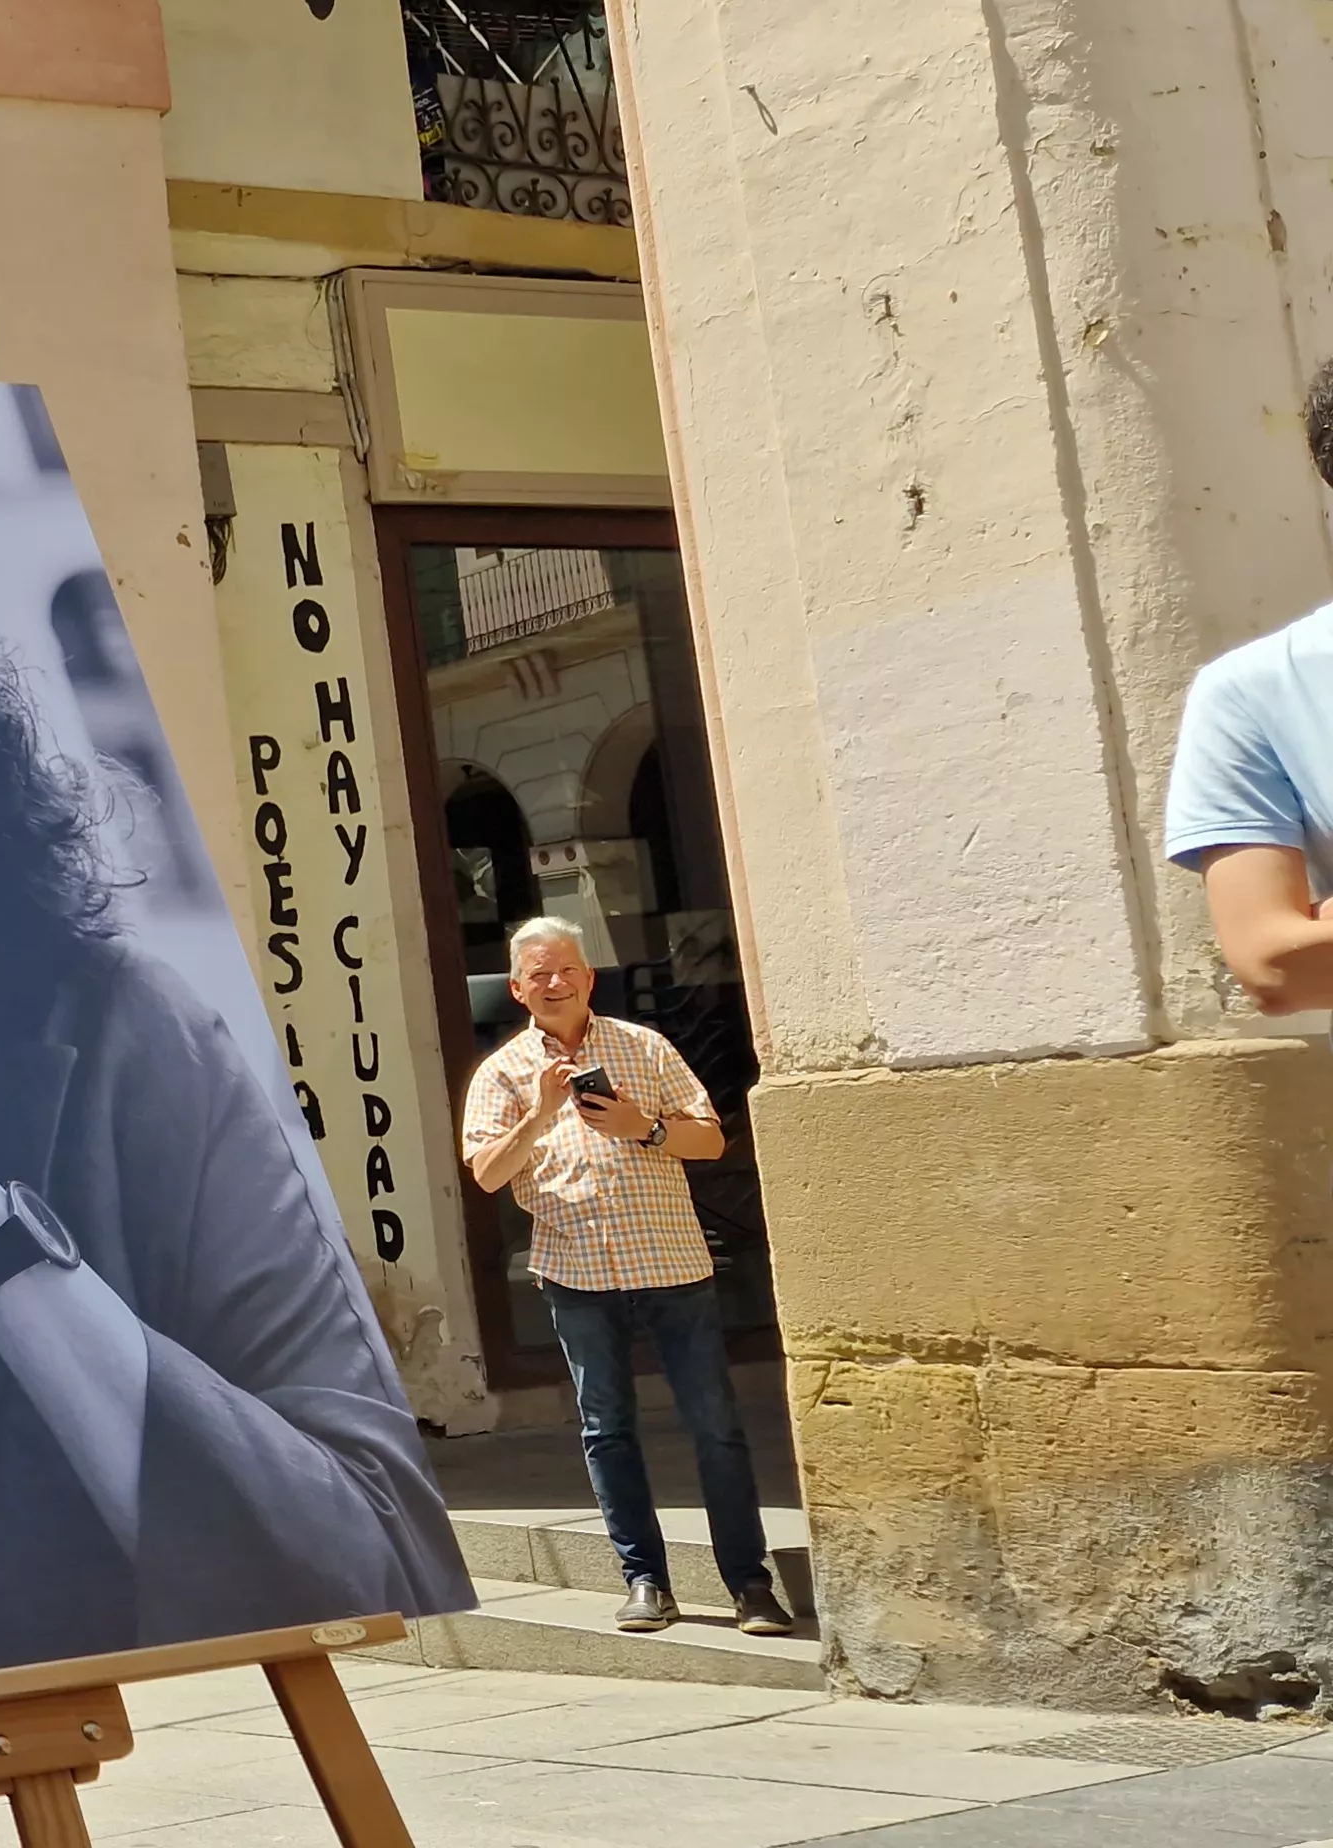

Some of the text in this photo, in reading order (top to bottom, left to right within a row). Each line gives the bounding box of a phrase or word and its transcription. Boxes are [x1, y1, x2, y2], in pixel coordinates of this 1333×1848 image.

[281, 521, 404, 1262] NO HAY CIUDAD
